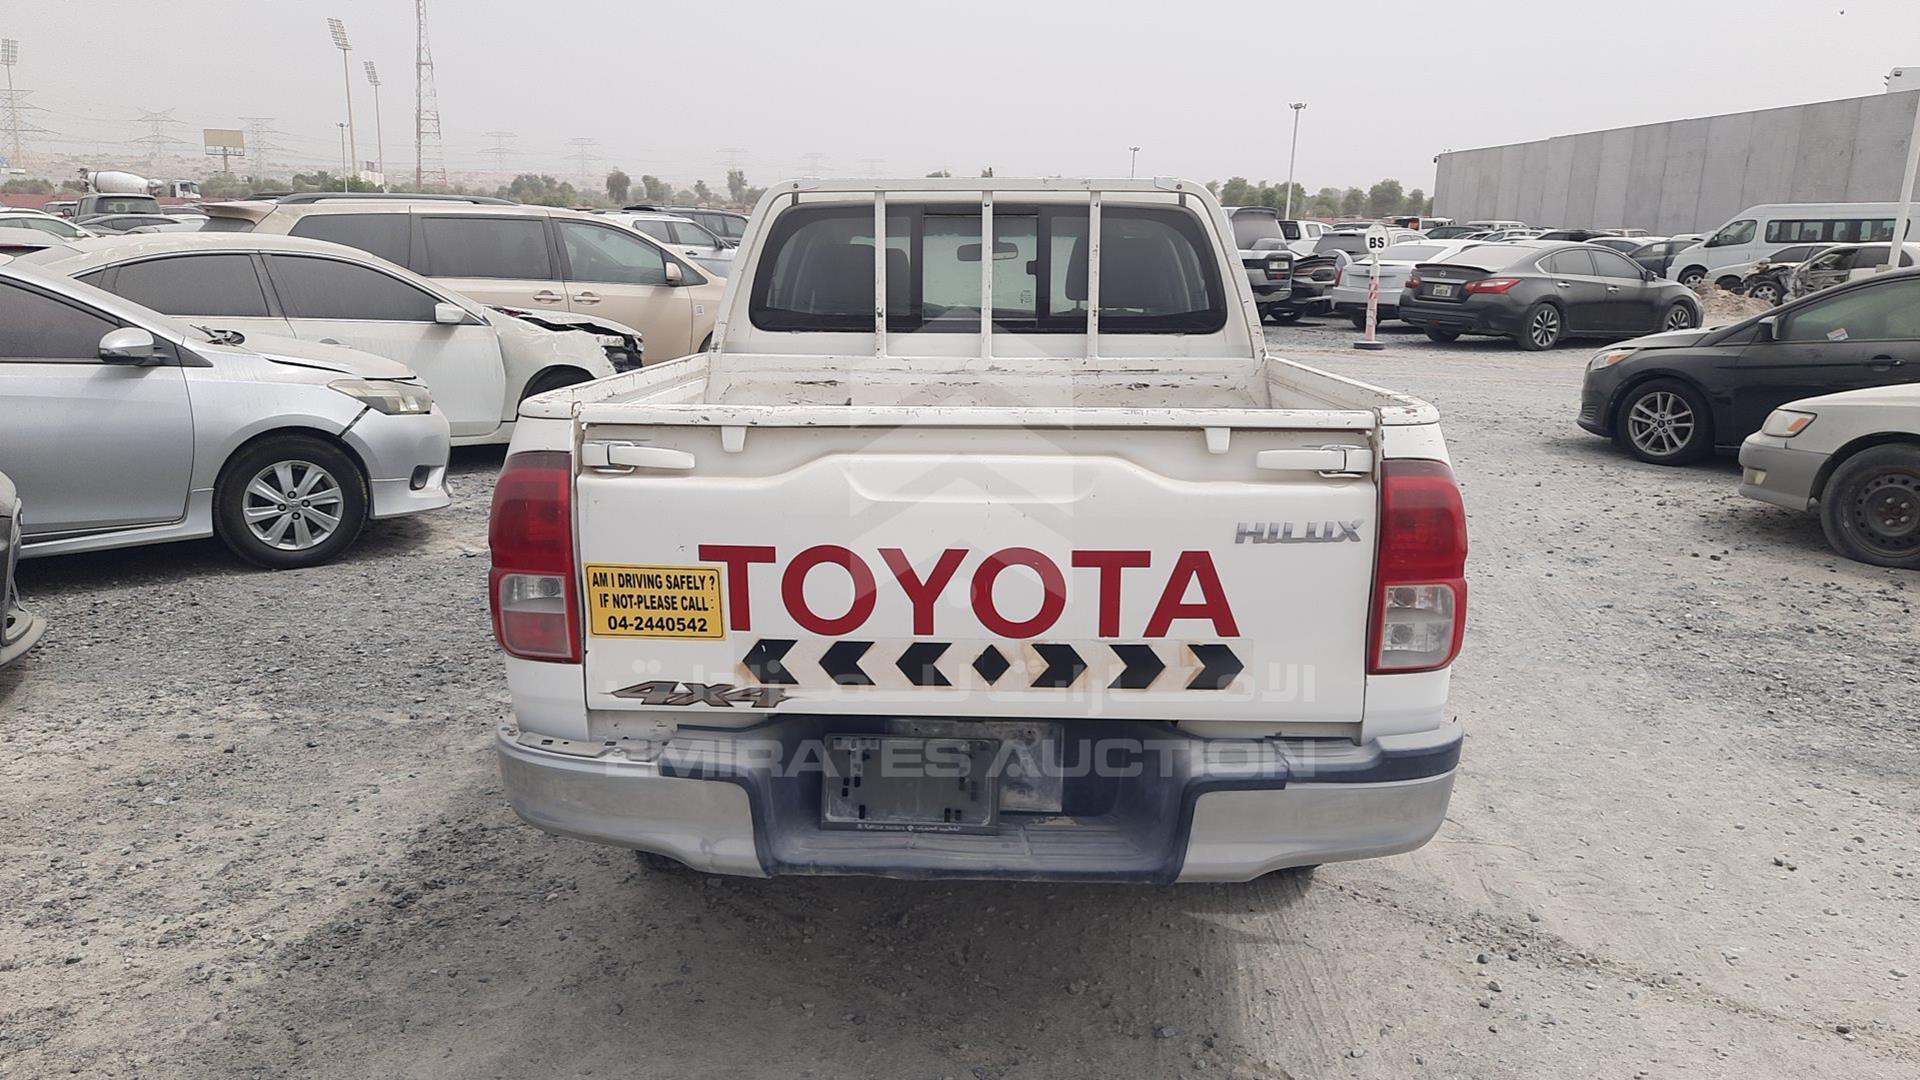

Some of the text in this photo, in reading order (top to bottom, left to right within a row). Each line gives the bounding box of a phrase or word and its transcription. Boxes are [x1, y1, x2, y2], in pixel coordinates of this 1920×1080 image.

[1369, 237, 1385, 249] BS
[1234, 519, 1363, 544] HILUX
[592, 572, 608, 587] AM
[611, 573, 615, 587] I
[618, 573, 662, 589] DRIVING
[666, 574, 706, 590] SAFELY
[698, 544, 1241, 639] TOYOTA
[599, 593, 609, 608] IF
[612, 594, 678, 610] NOT-PLEASE
[681, 596, 709, 611] CALL
[608, 615, 708, 632] 04-2440542
